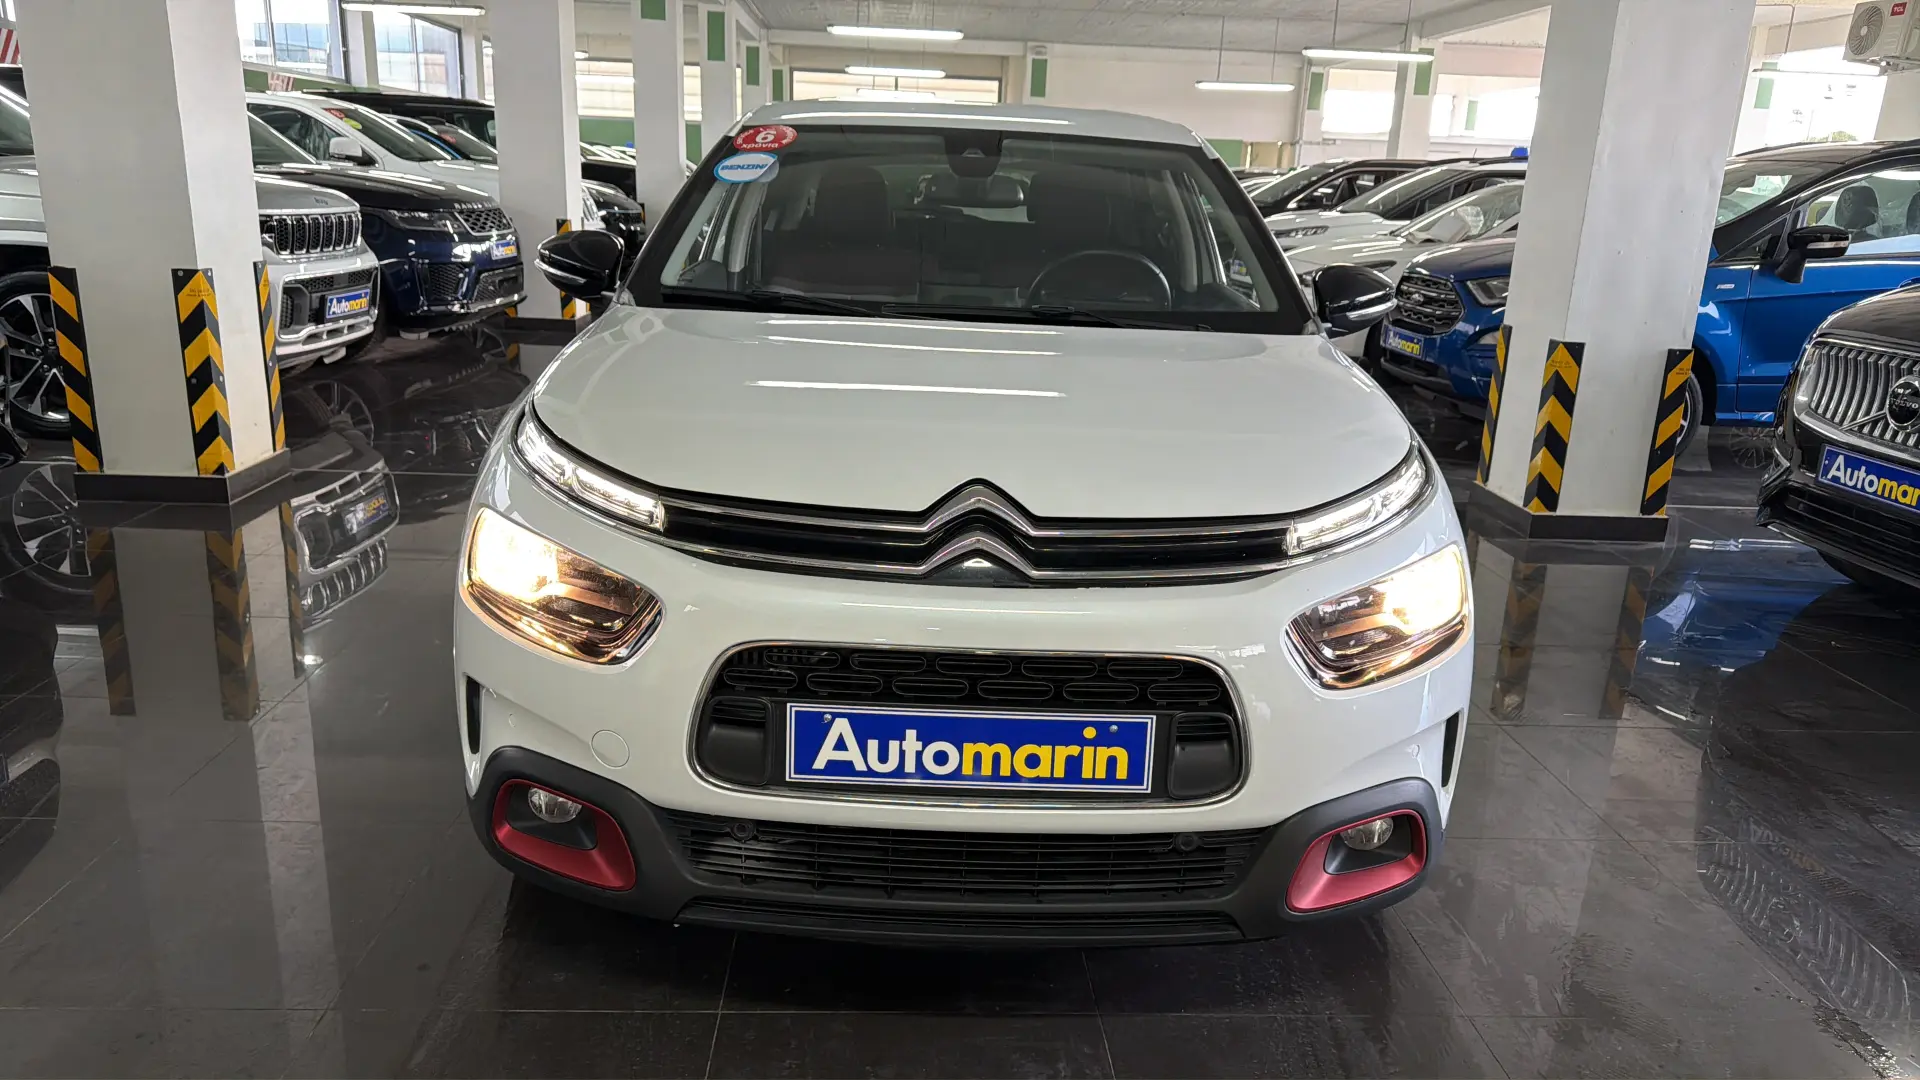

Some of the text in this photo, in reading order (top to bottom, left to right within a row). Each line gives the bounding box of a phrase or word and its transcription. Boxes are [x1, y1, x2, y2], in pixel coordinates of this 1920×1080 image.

[755, 130, 777, 143] 6
[329, 292, 368, 315] Automarin
[1387, 330, 1421, 356] Automarin
[811, 717, 1129, 780] Automarin
